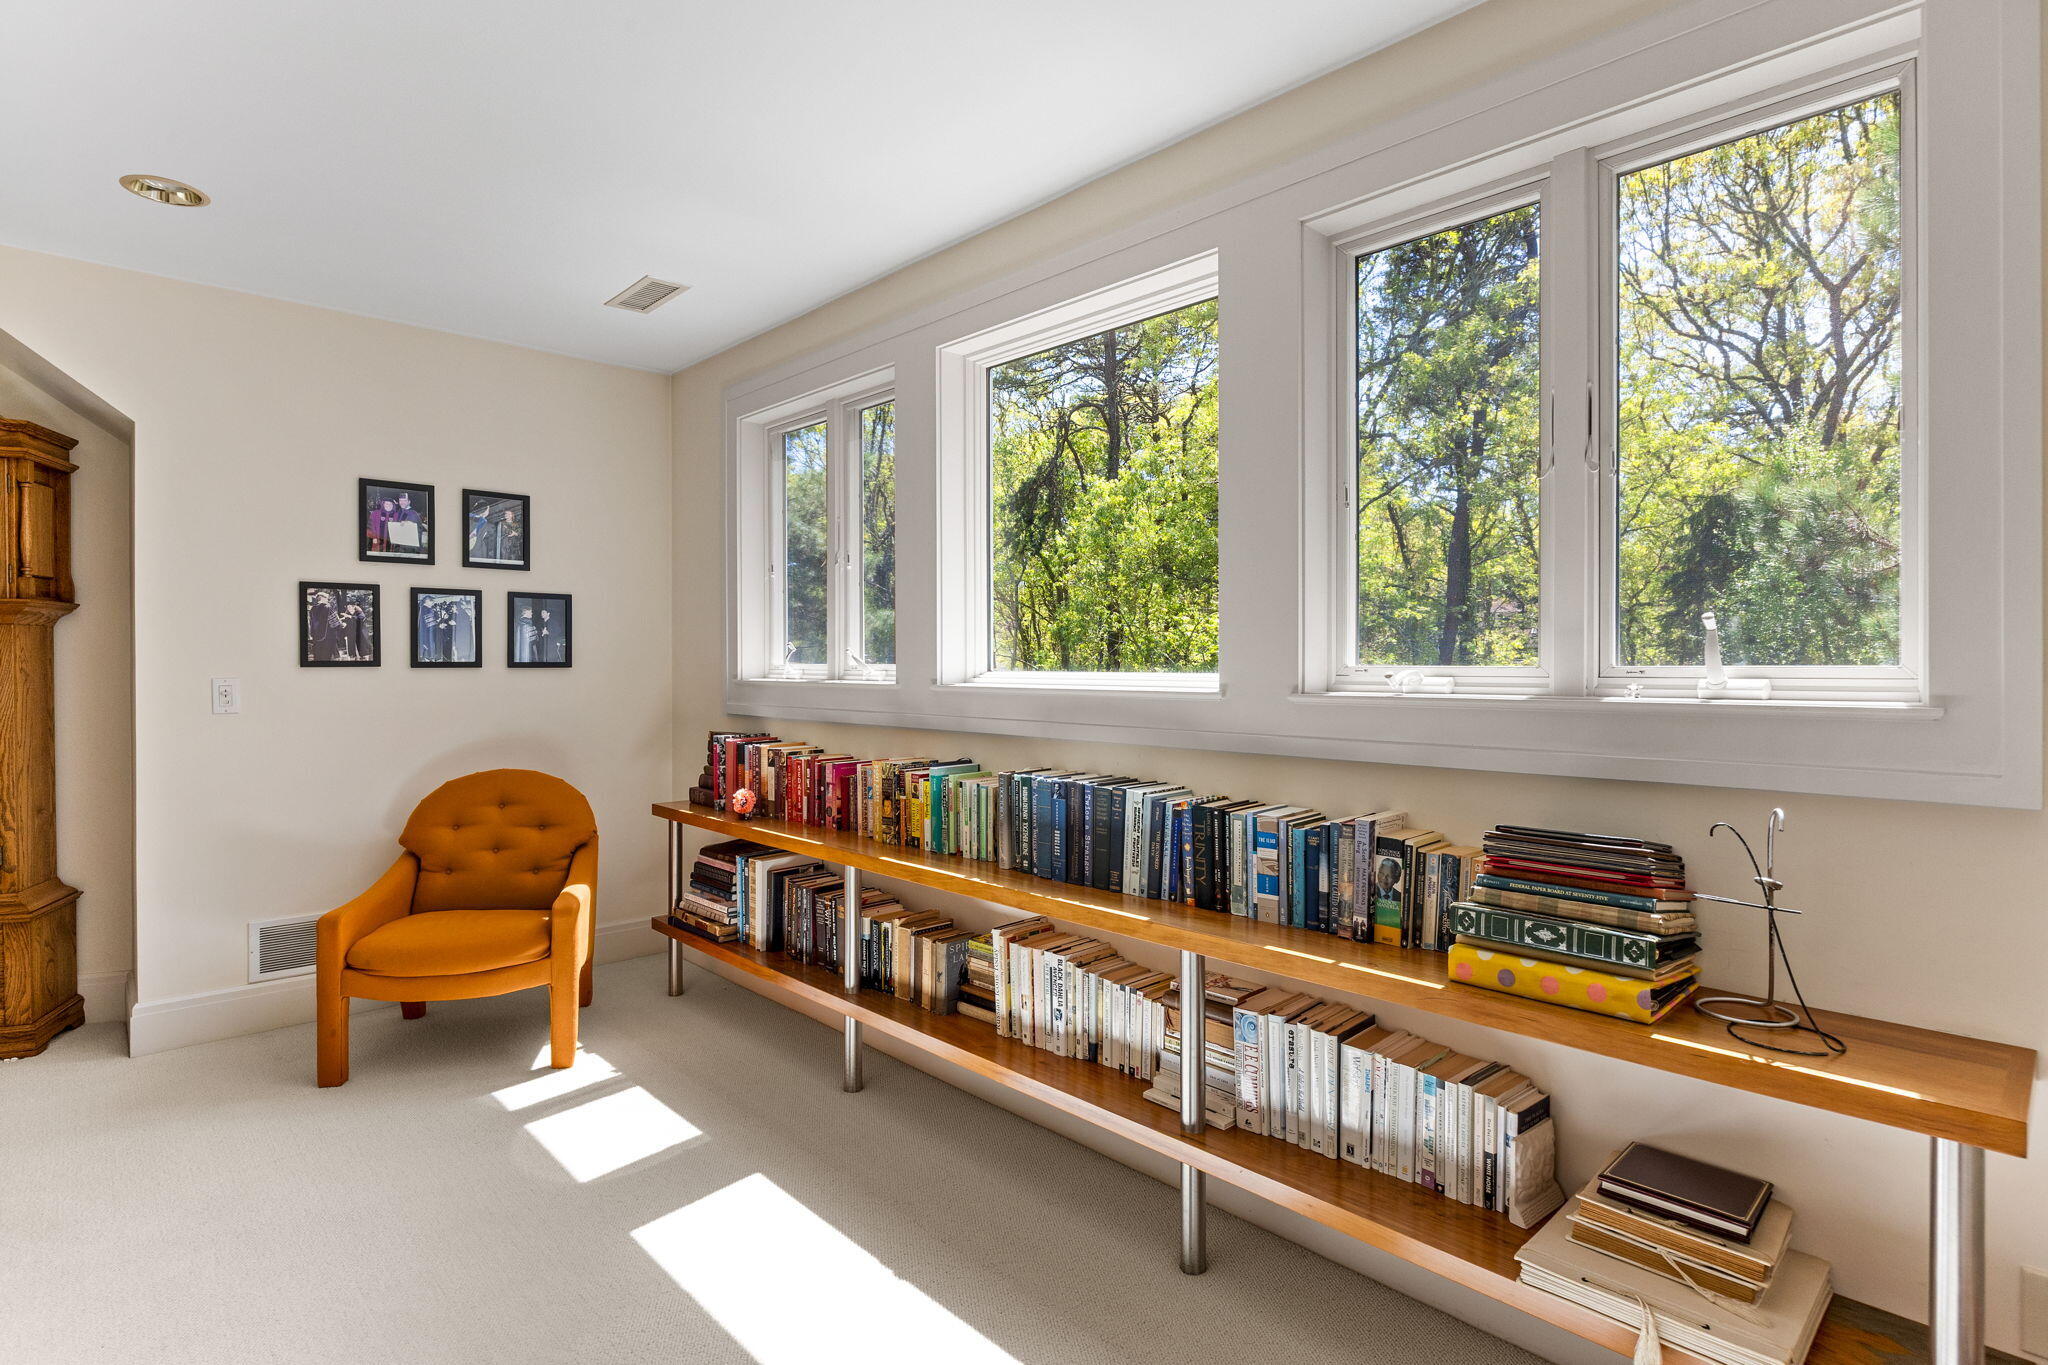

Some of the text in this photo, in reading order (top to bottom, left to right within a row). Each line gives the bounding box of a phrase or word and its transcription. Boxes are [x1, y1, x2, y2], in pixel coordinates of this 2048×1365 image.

[1194, 820, 1206, 886] TRINITY
[1331, 873, 1339, 886] MAN
[1331, 887, 1339, 907] CALLED
[1509, 882, 1531, 890] FEDERAL
[1531, 885, 1546, 893] PAPER
[1547, 887, 1565, 896] BOARD
[1572, 891, 1609, 901] SEVENTY-FIVE
[1331, 907, 1339, 918] OVE
[1244, 1064, 1259, 1114] CUMMINGS
